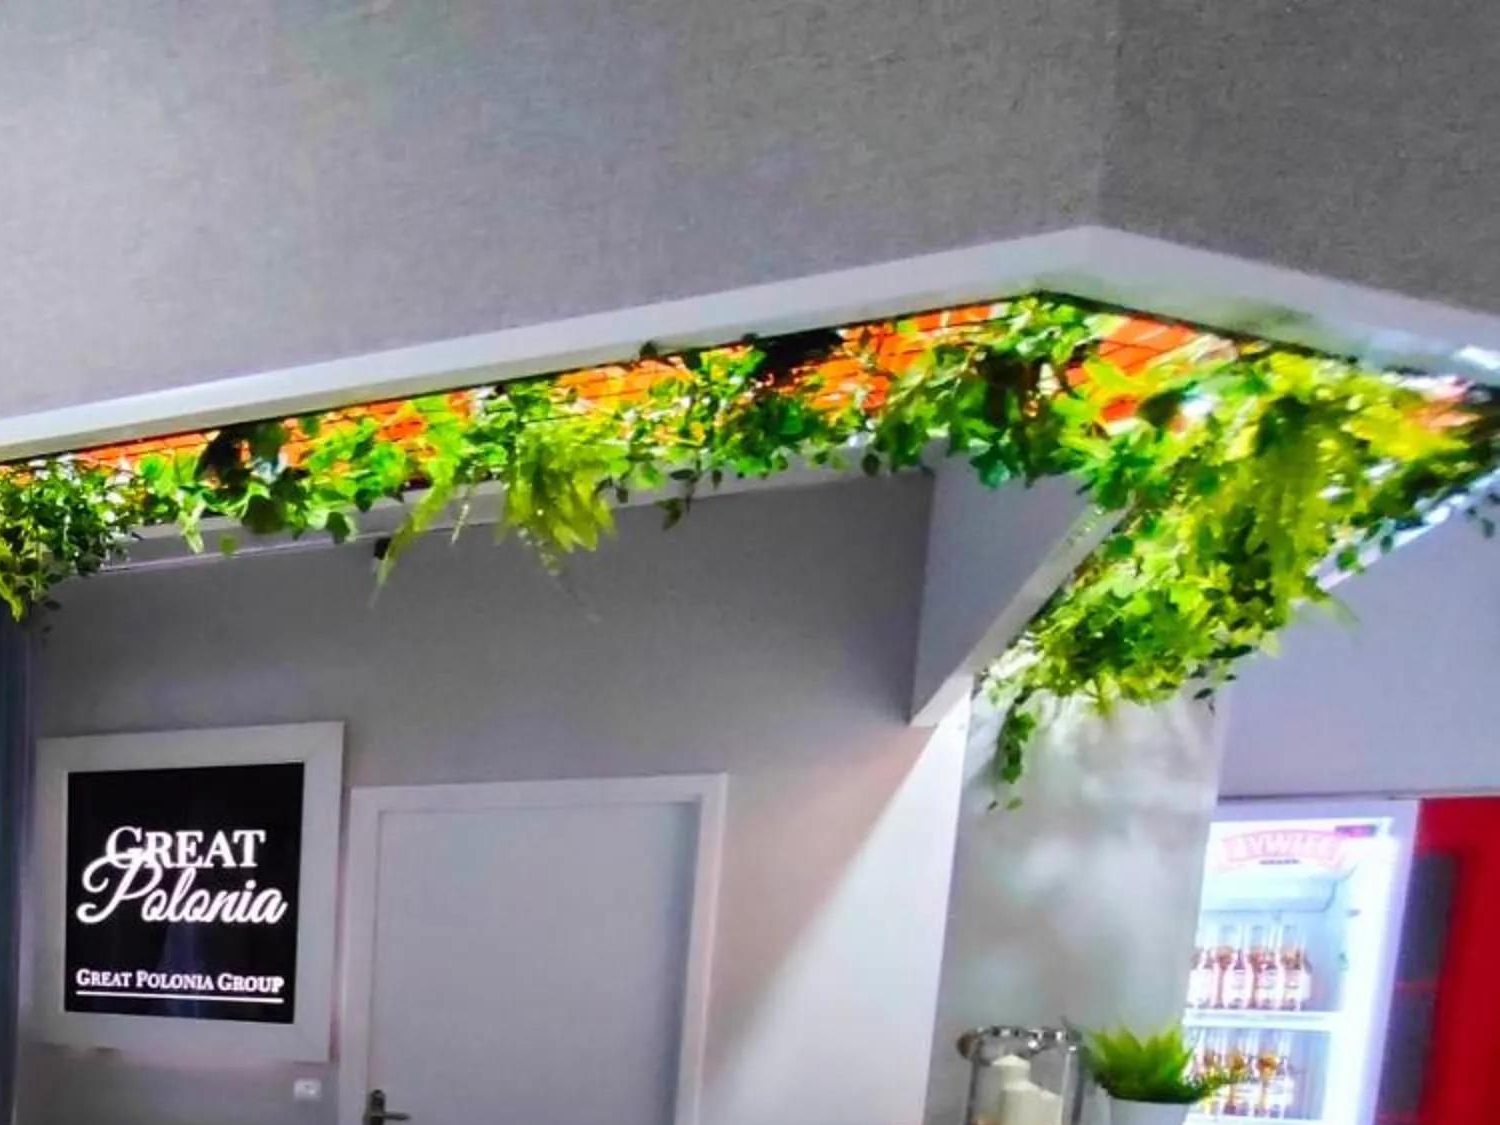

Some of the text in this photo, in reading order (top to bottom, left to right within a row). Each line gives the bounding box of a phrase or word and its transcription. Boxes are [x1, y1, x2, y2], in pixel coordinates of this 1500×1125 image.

[105, 825, 267, 869] GREAT
[75, 847, 288, 924] Polonia
[75, 968, 285, 994] GREAT POLONIA GROUP
